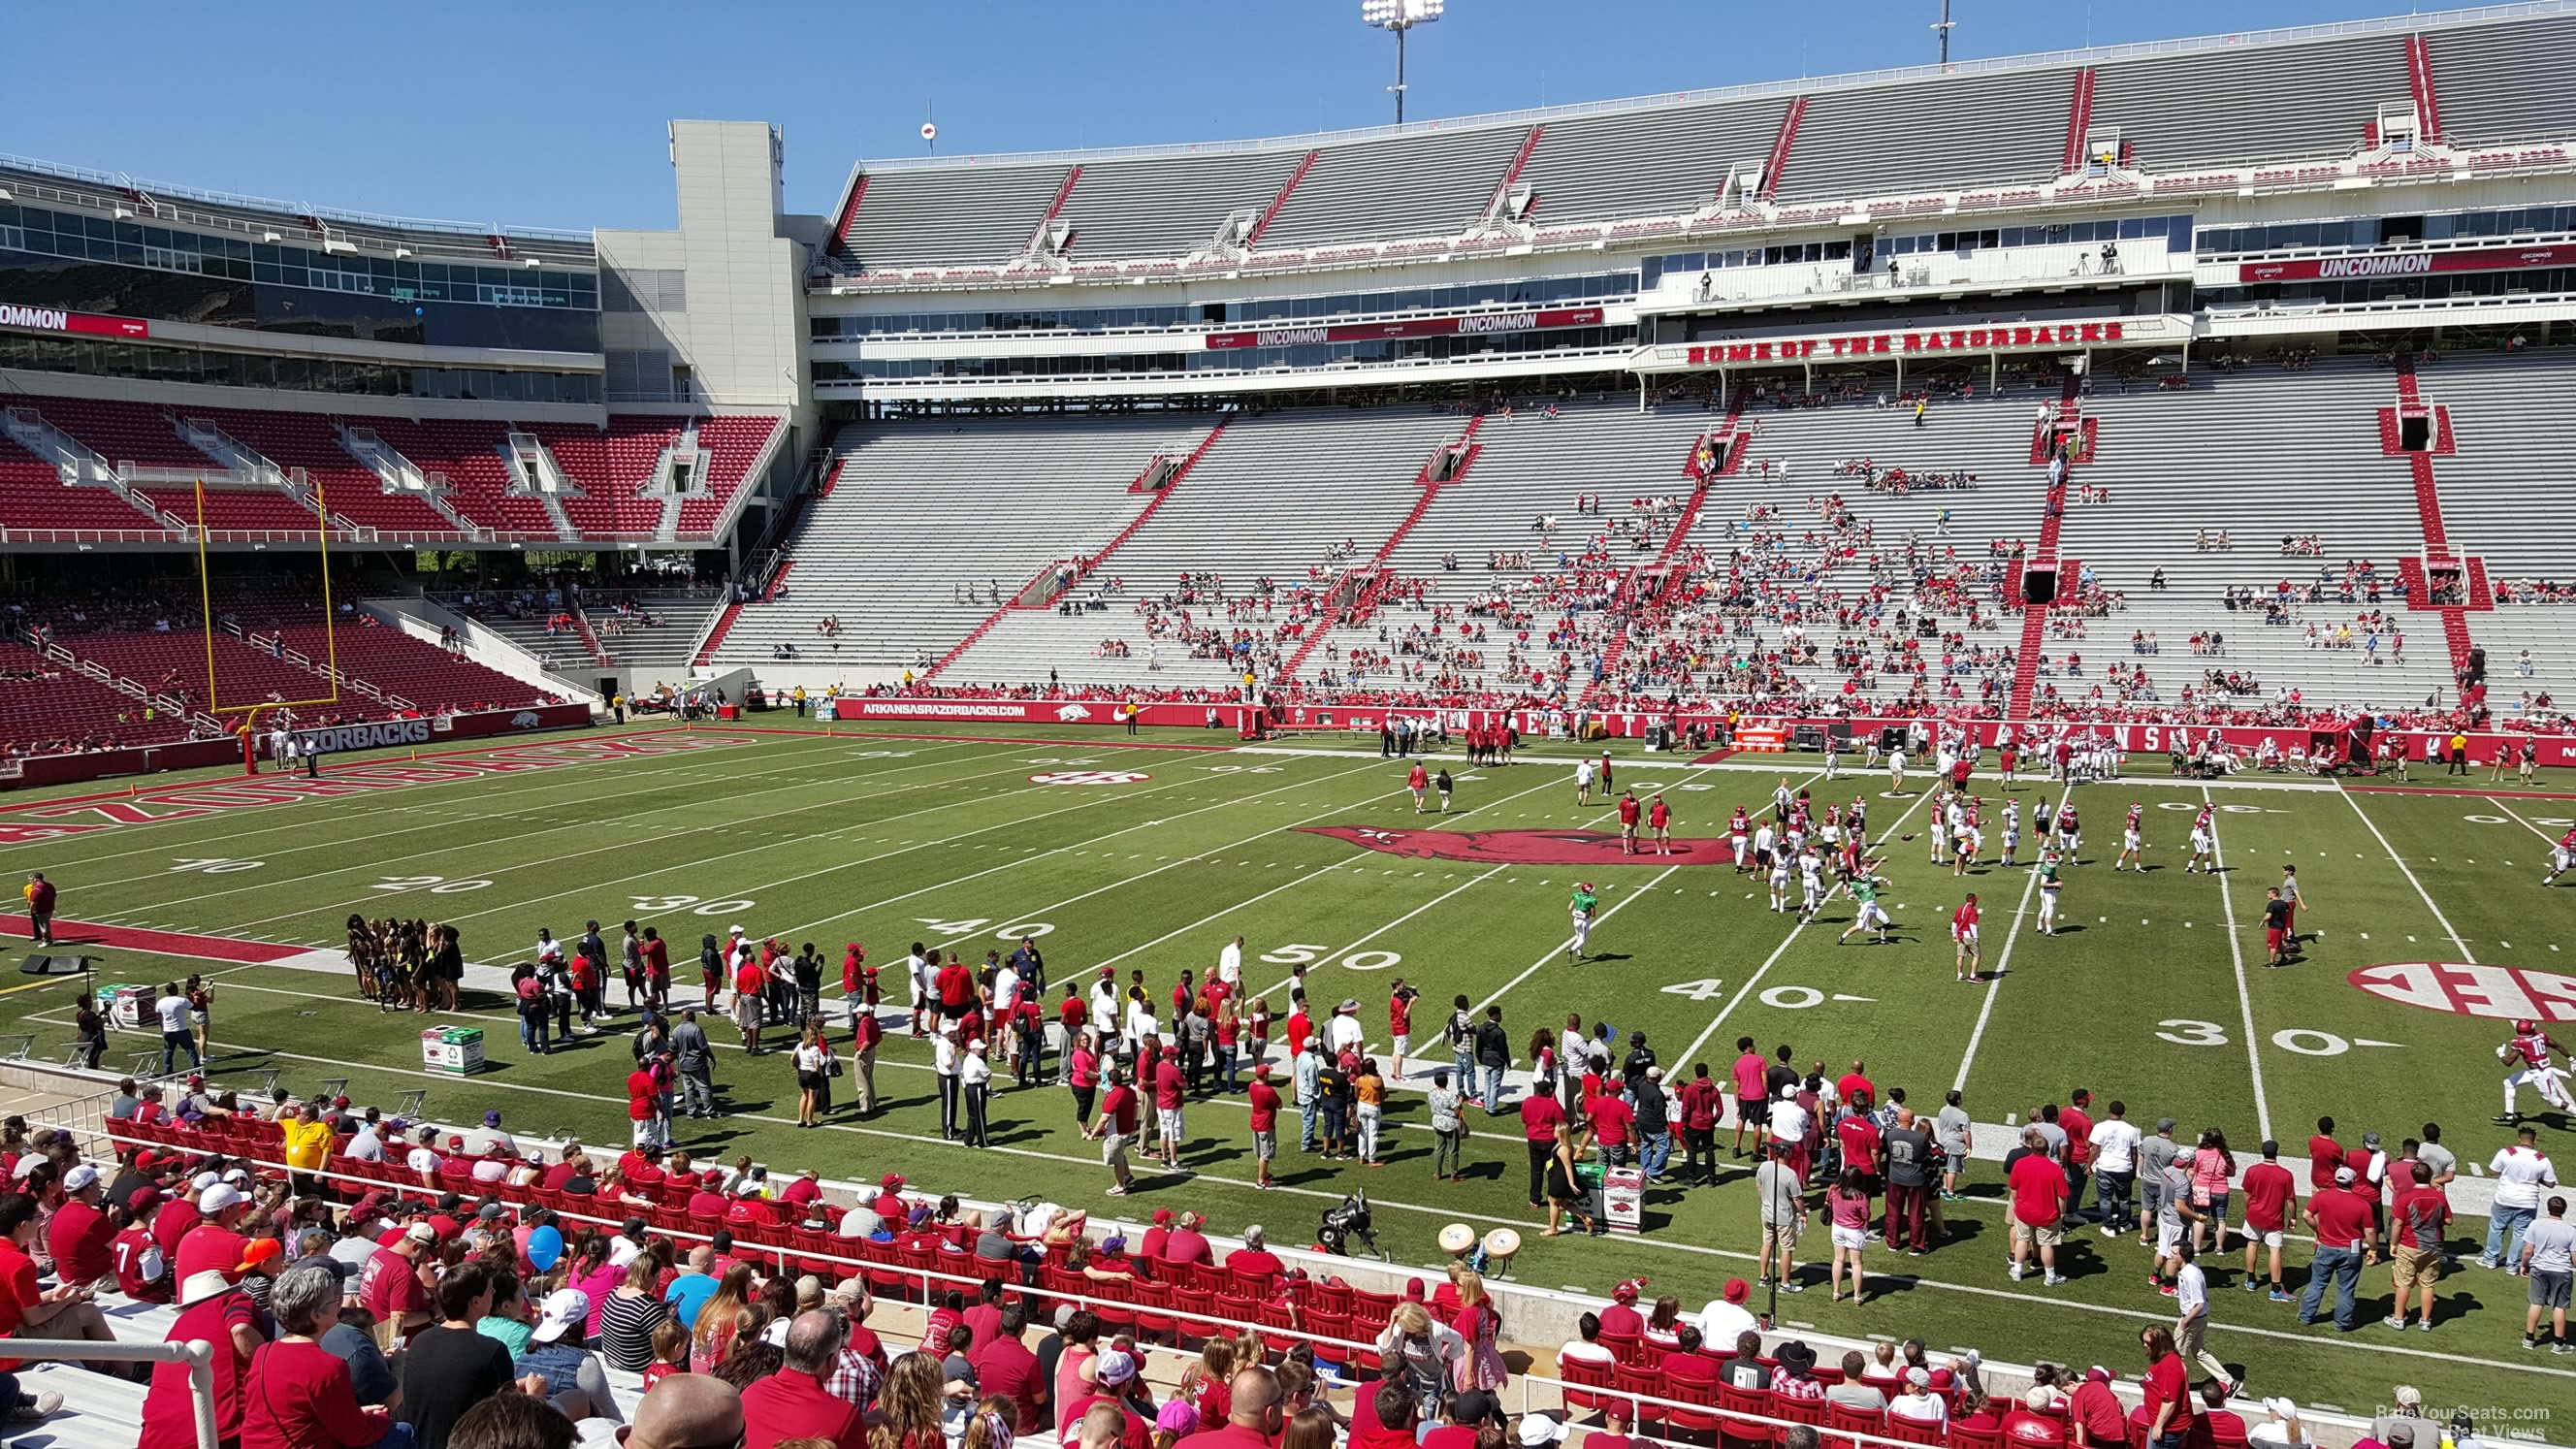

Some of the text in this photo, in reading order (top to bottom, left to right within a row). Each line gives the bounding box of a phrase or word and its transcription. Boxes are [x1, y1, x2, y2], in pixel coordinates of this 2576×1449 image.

[2319, 254, 2432, 277] UNCOMMON
[1458, 313, 1536, 333] UNCOMMON
[1257, 328, 1328, 346] UNCOMMON
[1689, 322, 2122, 364] HOME OF THE RAZORBACKS
[863, 703, 1025, 716] ARKANSASRAZORBACKS.COM
[273, 721, 430, 759] AZORBACKS
[1732, 821, 1745, 830] 45
[182, 857, 266, 874] 10
[1804, 862, 1810, 872] 3
[385, 875, 494, 894] 20
[1860, 883, 1870, 892] 5
[636, 895, 756, 917] 30
[927, 918, 1056, 940] 40
[1258, 944, 1402, 970] 50
[1659, 978, 1824, 1009] 40
[2154, 1017, 2350, 1056] 30
[2532, 1039, 2546, 1056] 16
[116, 1241, 131, 1273] 7
[1421, 1344, 1432, 1354] PIG
[1315, 1367, 1337, 1377] COX
